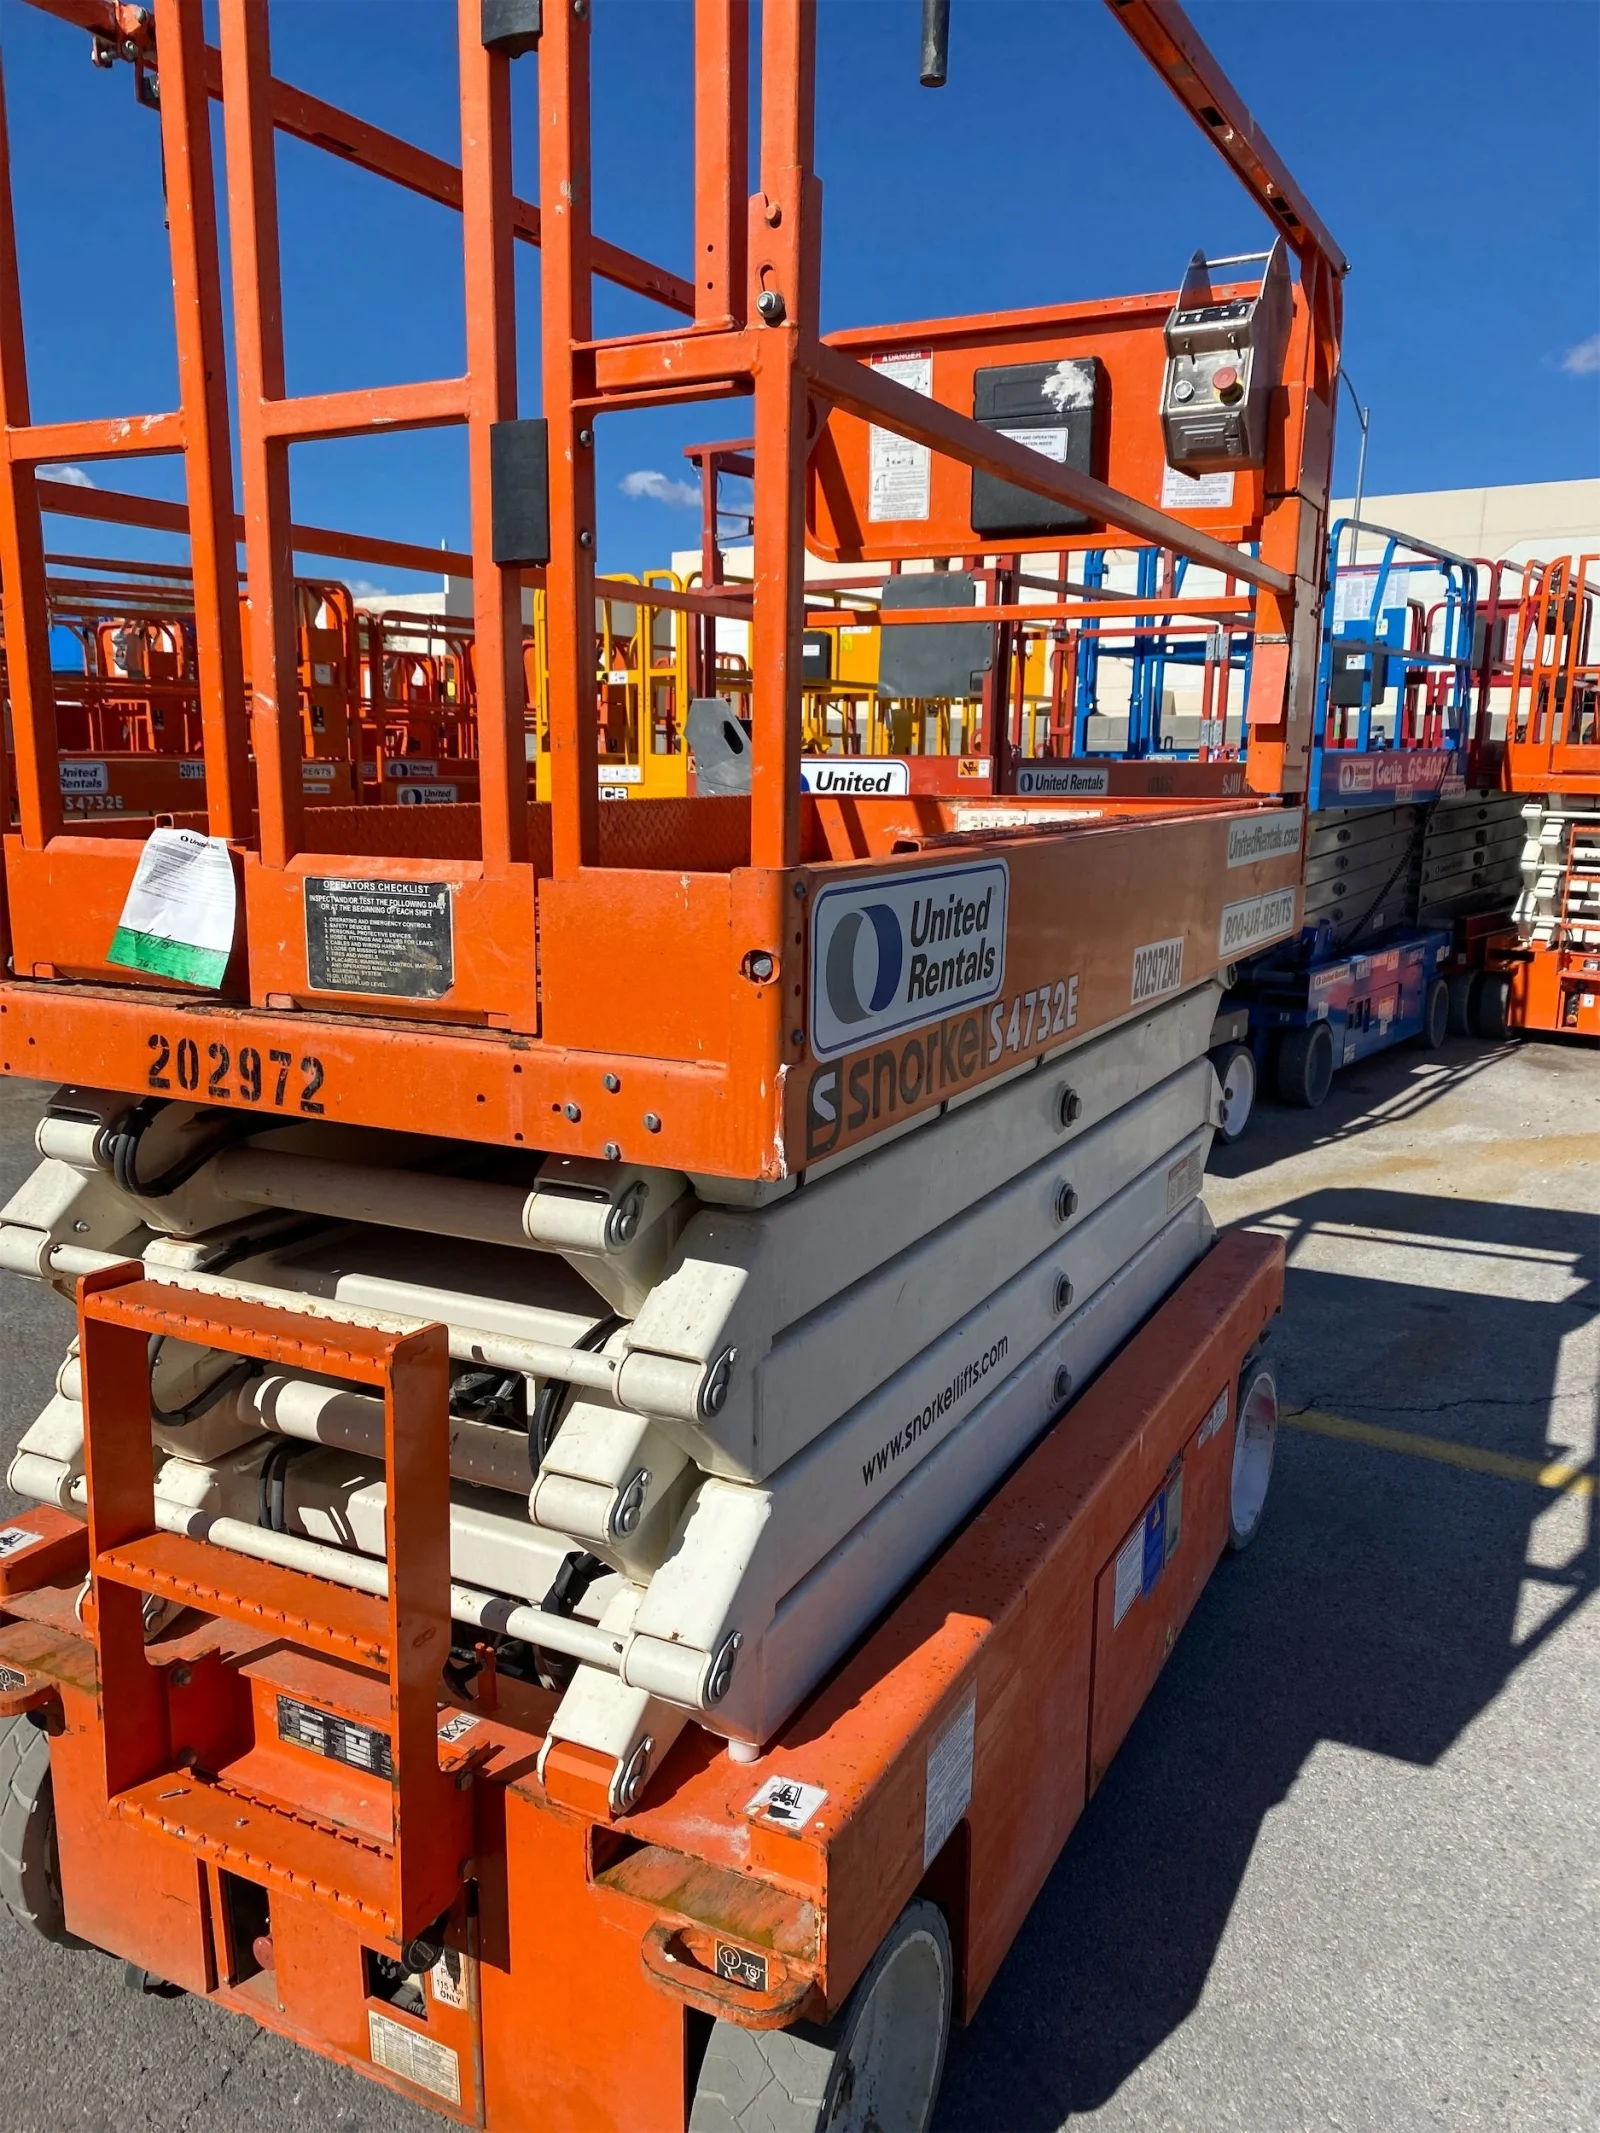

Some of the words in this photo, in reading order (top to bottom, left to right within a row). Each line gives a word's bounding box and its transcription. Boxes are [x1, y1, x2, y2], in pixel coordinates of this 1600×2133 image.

[816, 771, 892, 792] United
[1035, 773, 1068, 791] United
[1070, 773, 1104, 790] Rentals
[1376, 759, 1403, 785] Genie
[65, 796, 124, 811] S4732E
[424, 789, 452, 798] United
[598, 787, 628, 800] CB
[1229, 823, 1300, 860] UnitedRentals.com
[323, 880, 375, 890] OPERATORS
[377, 883, 430, 894] CHECKLIST
[352, 905, 385, 914] BEGINNING
[415, 909, 433, 917] SHIFT
[359, 897, 374, 905] TEST
[376, 898, 388, 906] THE
[389, 900, 426, 908] FOLLOWING
[910, 886, 993, 948] United
[1223, 896, 1293, 948] 800-UR-RENTS
[907, 937, 996, 1003] Rentals
[1133, 943, 1183, 1000] 202972AH
[988, 974, 1080, 1065] S4732E
[148, 1034, 325, 1115] 202972
[847, 1005, 989, 1131] snorkel
[862, 1335, 1009, 1487] www.snorkellifts.com
[440, 1990, 461, 2005] ONLY
